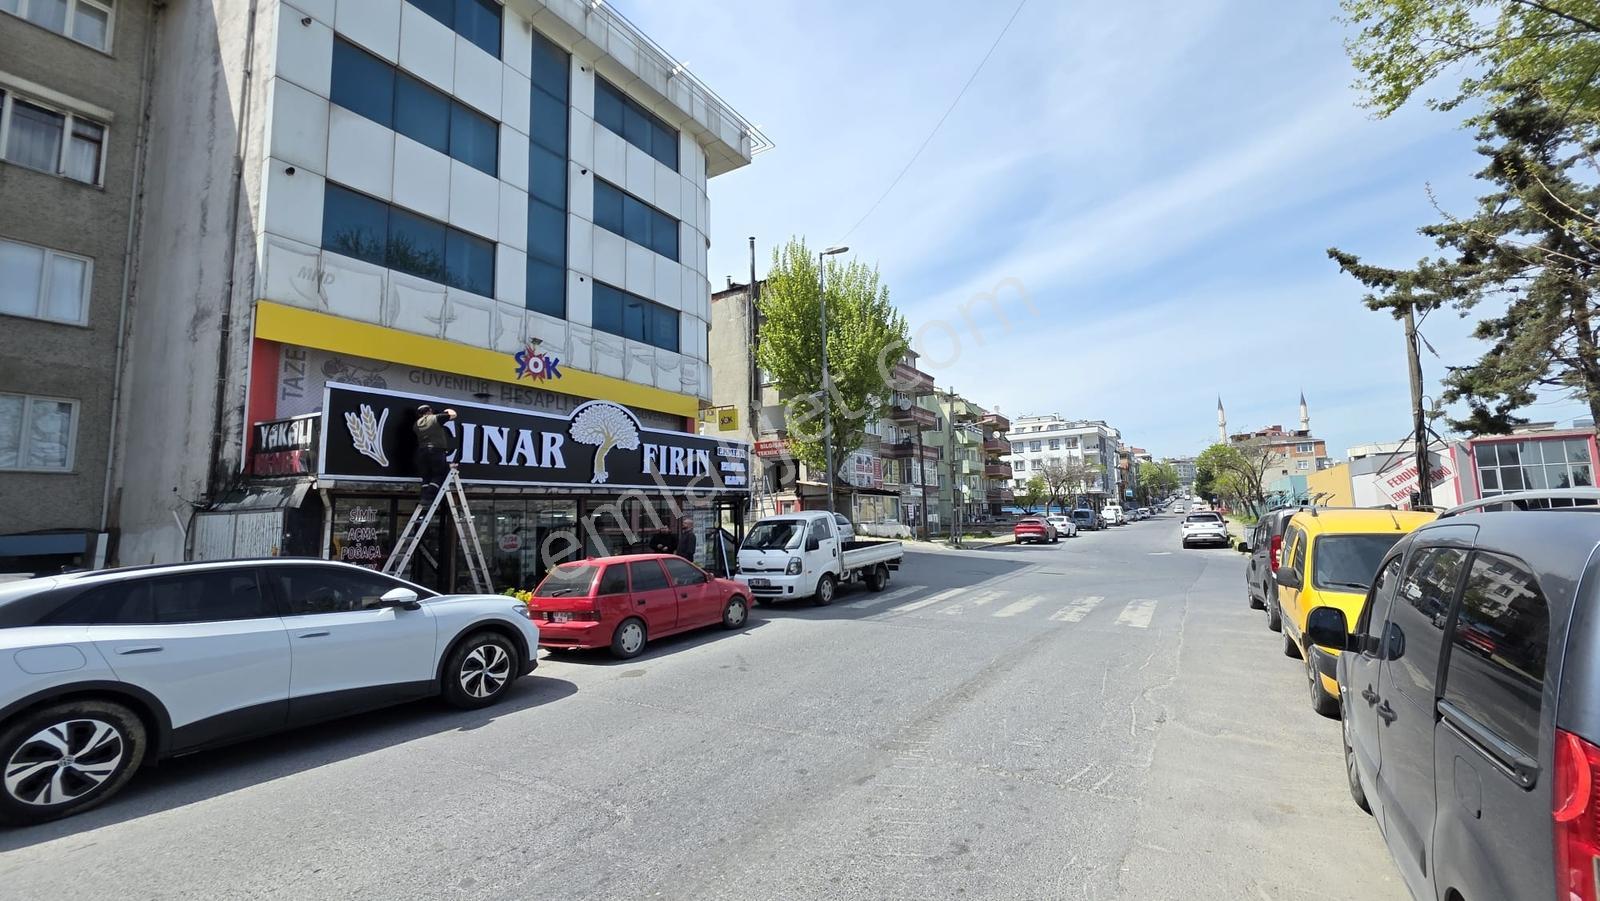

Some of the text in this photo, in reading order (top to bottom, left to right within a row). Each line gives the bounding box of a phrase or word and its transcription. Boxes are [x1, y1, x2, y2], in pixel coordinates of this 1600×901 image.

[281, 348, 306, 401] TAZE
[514, 350, 562, 380] ŞOK
[500, 384, 569, 411] HESAPLI
[260, 418, 313, 449] YAKALI
[642, 443, 711, 477] FIRIN
[349, 505, 378, 523] SİMİT
[347, 527, 378, 542] AÇMA
[340, 543, 382, 560] POĞAÇA
